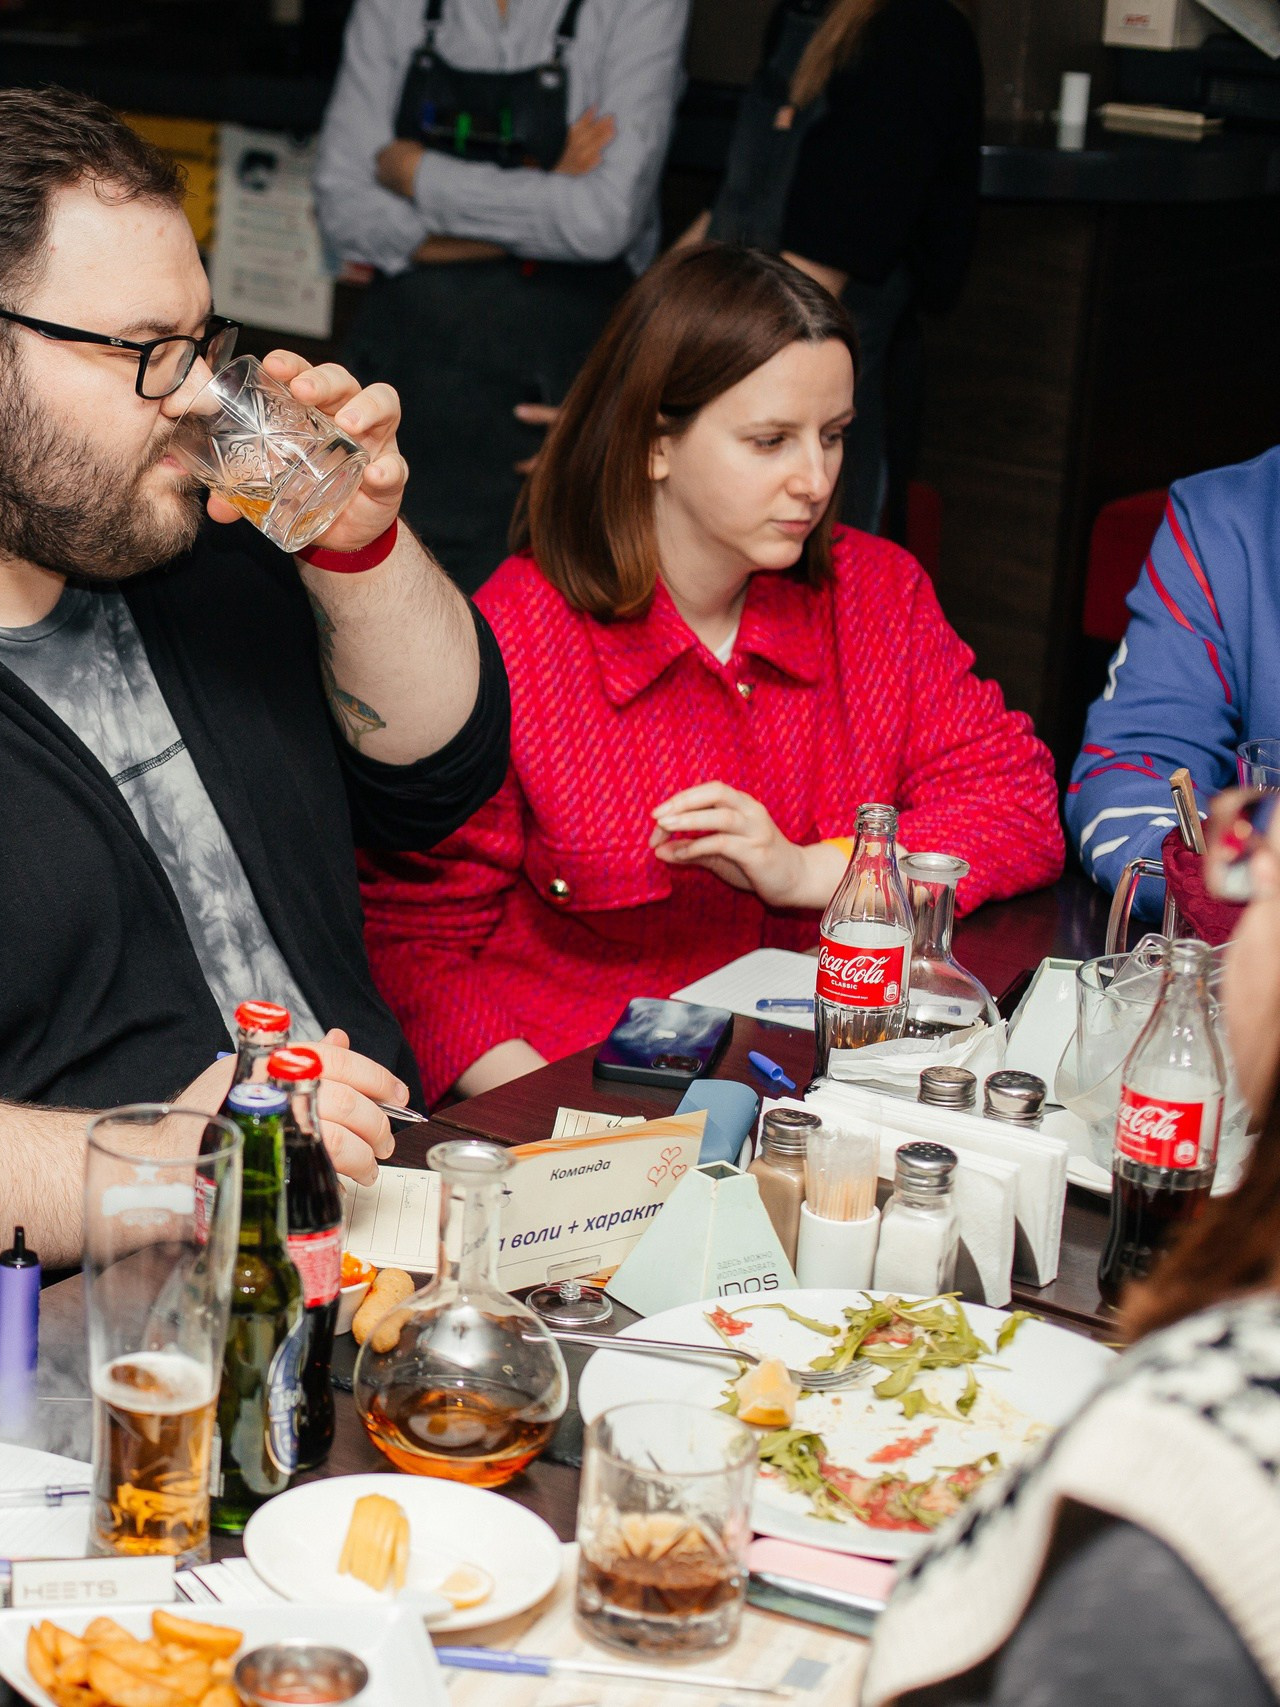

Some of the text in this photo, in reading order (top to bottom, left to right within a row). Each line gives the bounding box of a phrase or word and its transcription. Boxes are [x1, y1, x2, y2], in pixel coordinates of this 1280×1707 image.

[818, 945, 891, 984] Coca-Cola
[830, 979, 858, 990] CLASSIC
[549, 1159, 611, 1181] Команда
[511, 1224, 562, 1249] воли
[22, 1579, 118, 1600] HEETS
